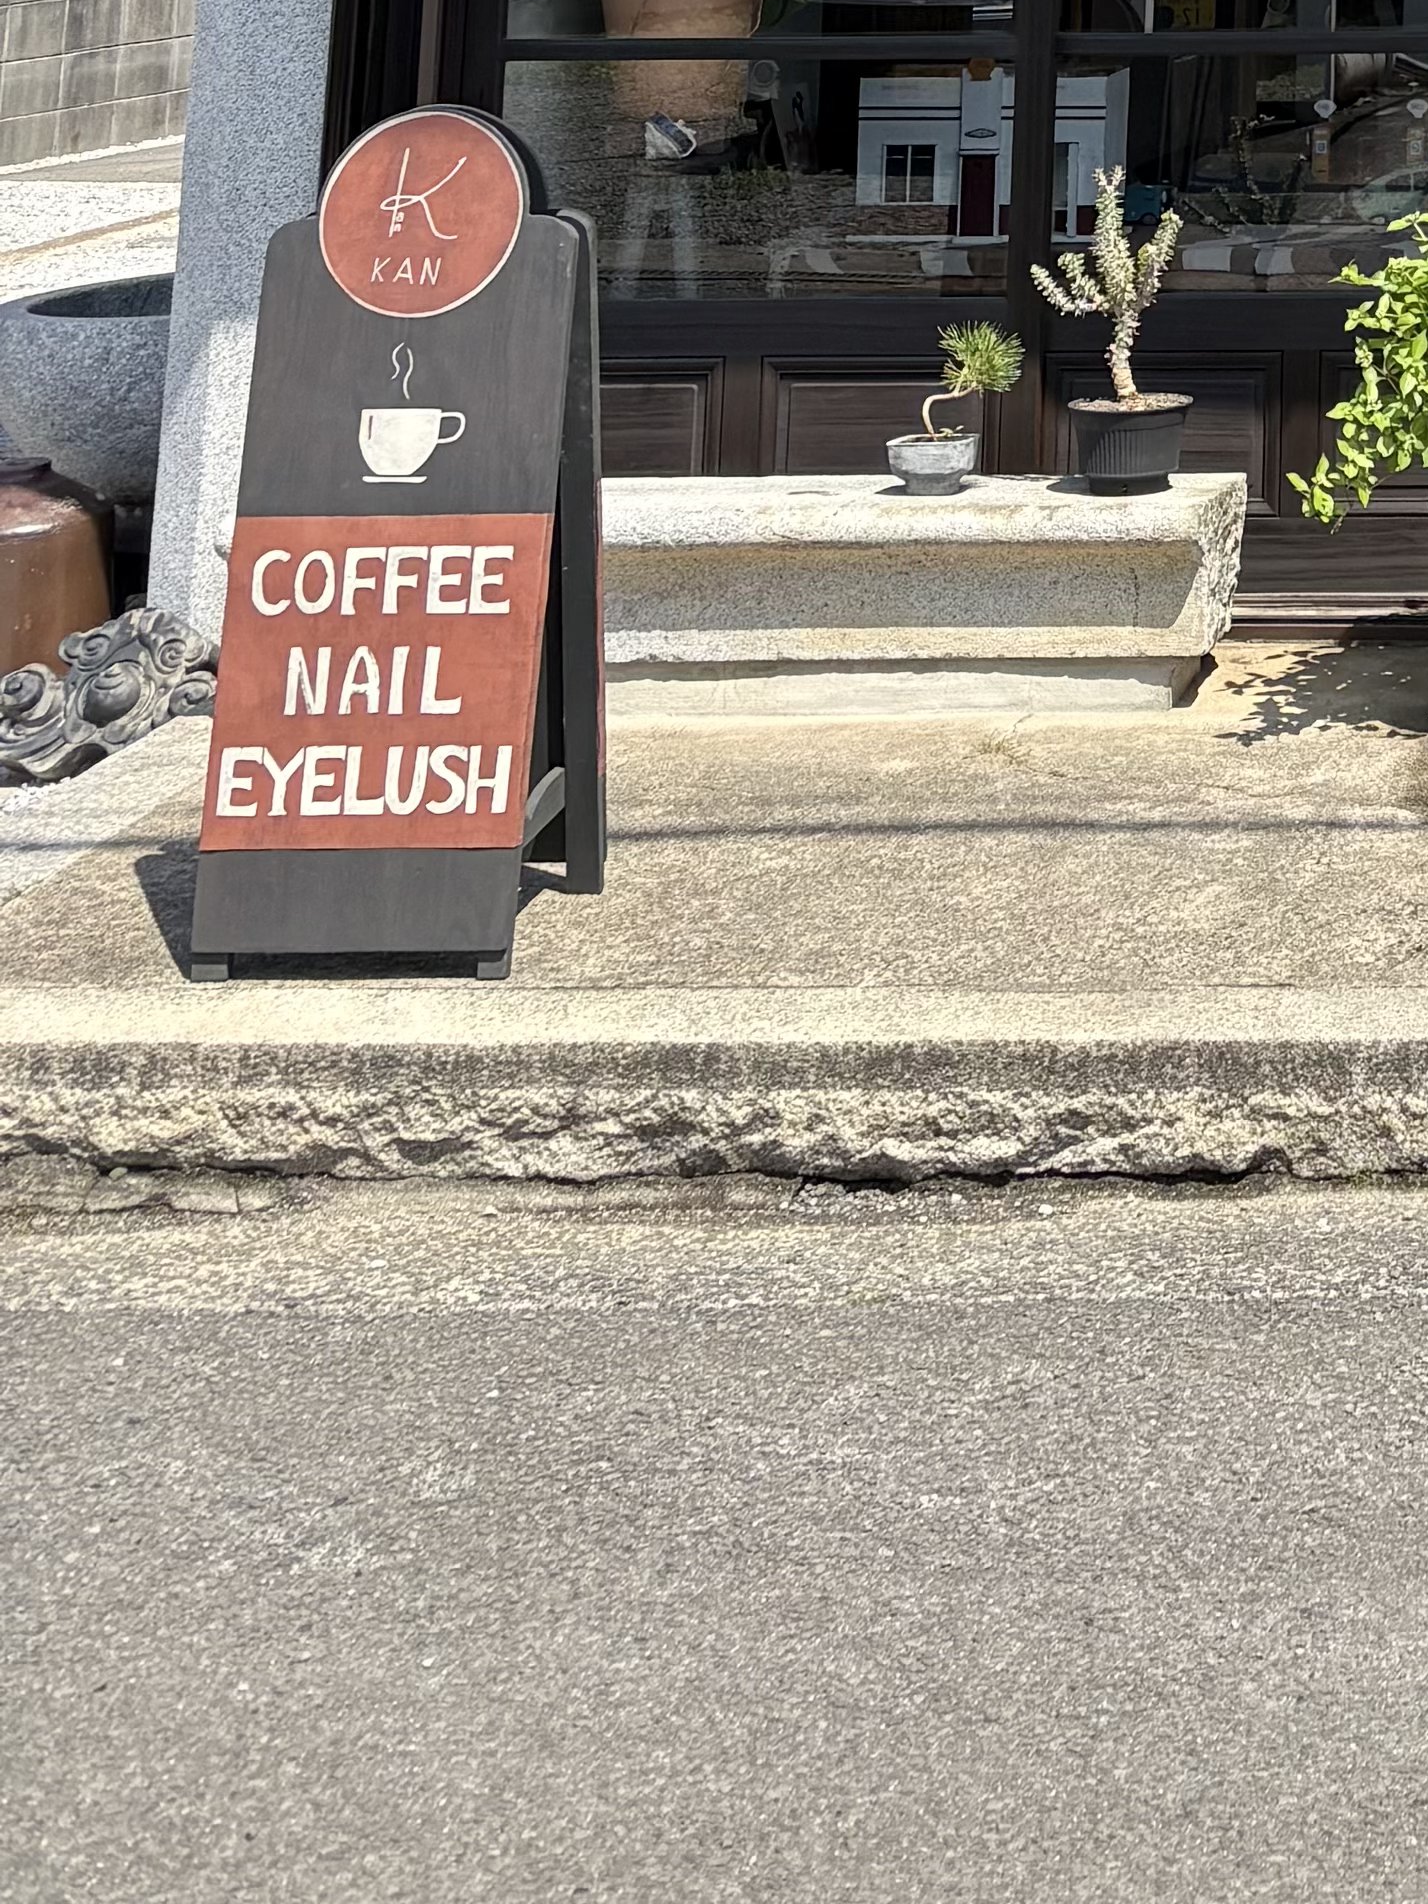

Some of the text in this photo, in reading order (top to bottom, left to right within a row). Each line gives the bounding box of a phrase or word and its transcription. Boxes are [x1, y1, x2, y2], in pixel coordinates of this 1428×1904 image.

[369, 256, 442, 286] KAN
[251, 544, 515, 617] COFFEE
[283, 645, 463, 716] NAIL
[215, 744, 514, 818] EYELUSH
